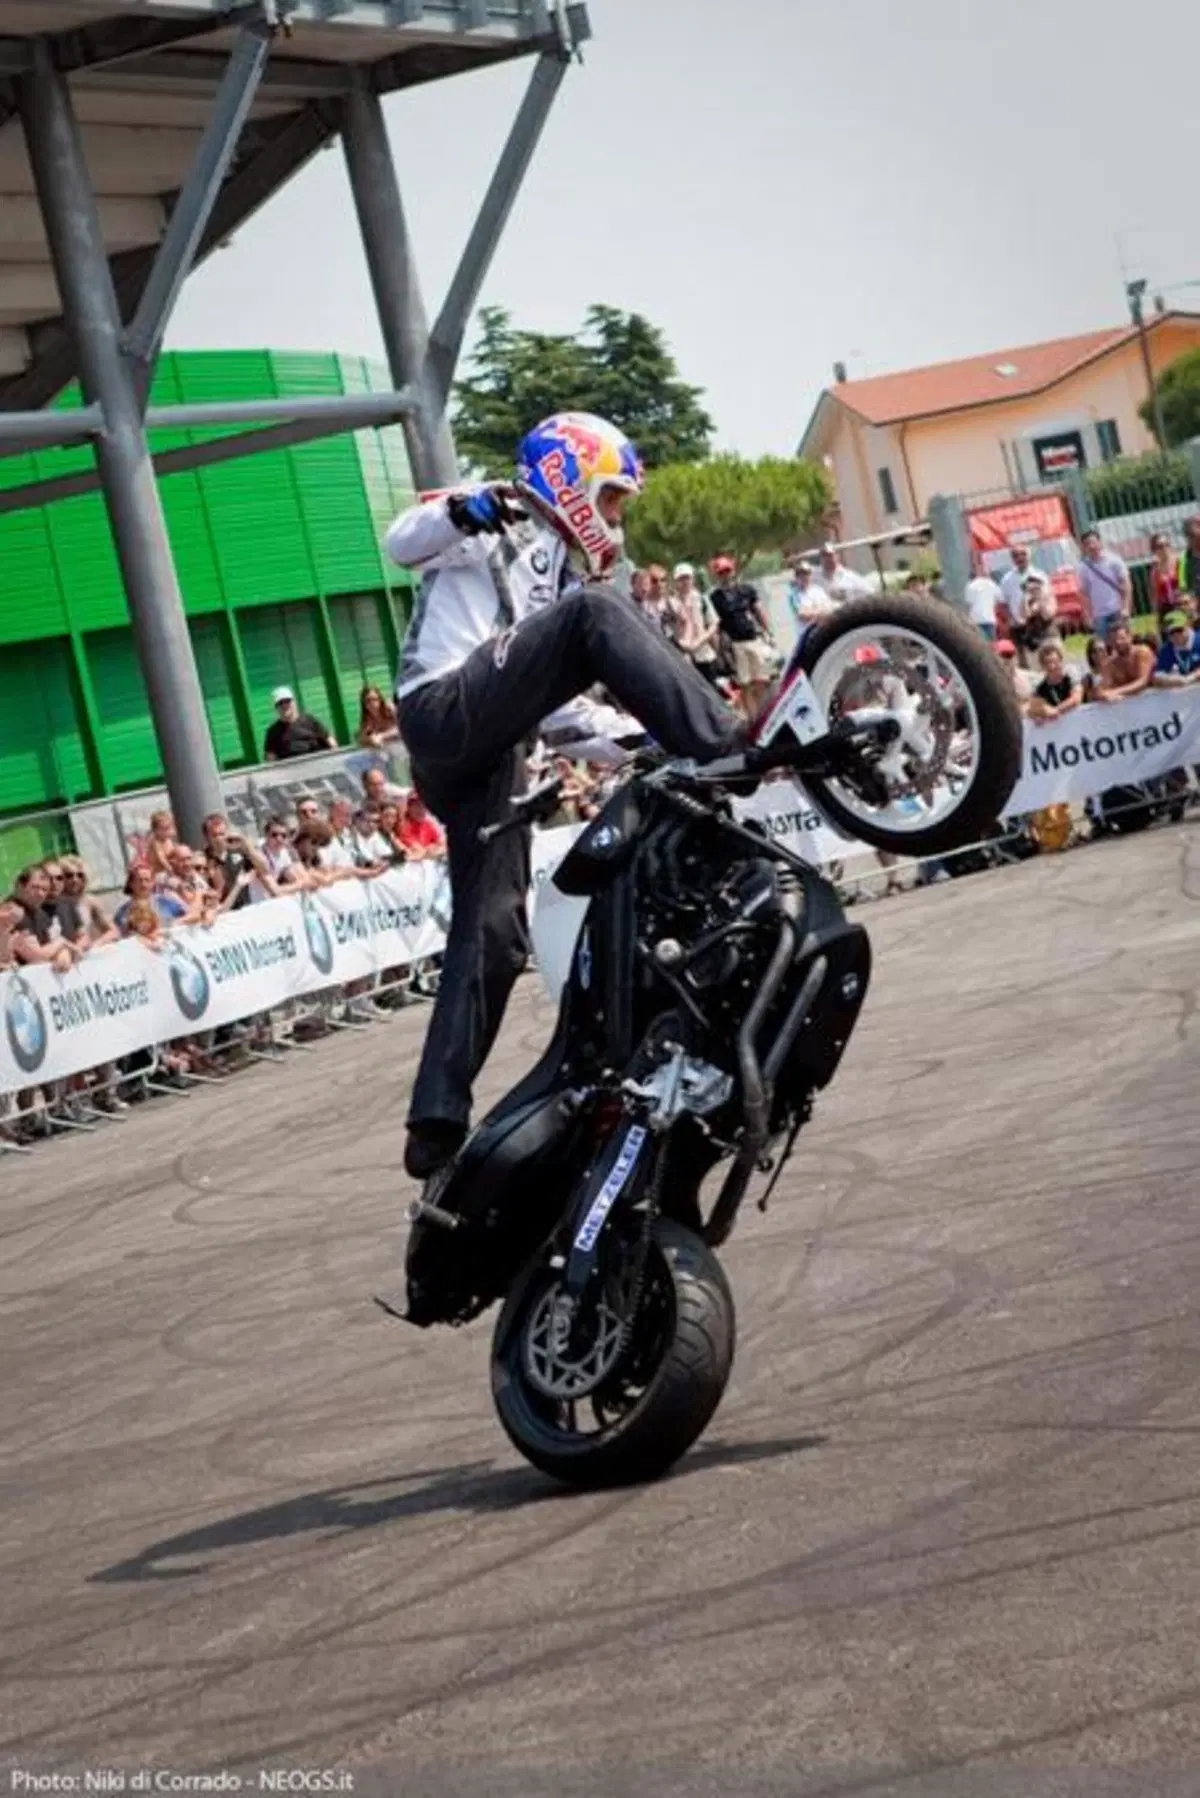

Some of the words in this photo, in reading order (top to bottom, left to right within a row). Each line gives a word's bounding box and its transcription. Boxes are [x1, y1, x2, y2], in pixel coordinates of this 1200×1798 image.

[541, 451, 587, 509] Red
[568, 503, 612, 554] Bull
[1030, 711, 1183, 775] Motorrad
